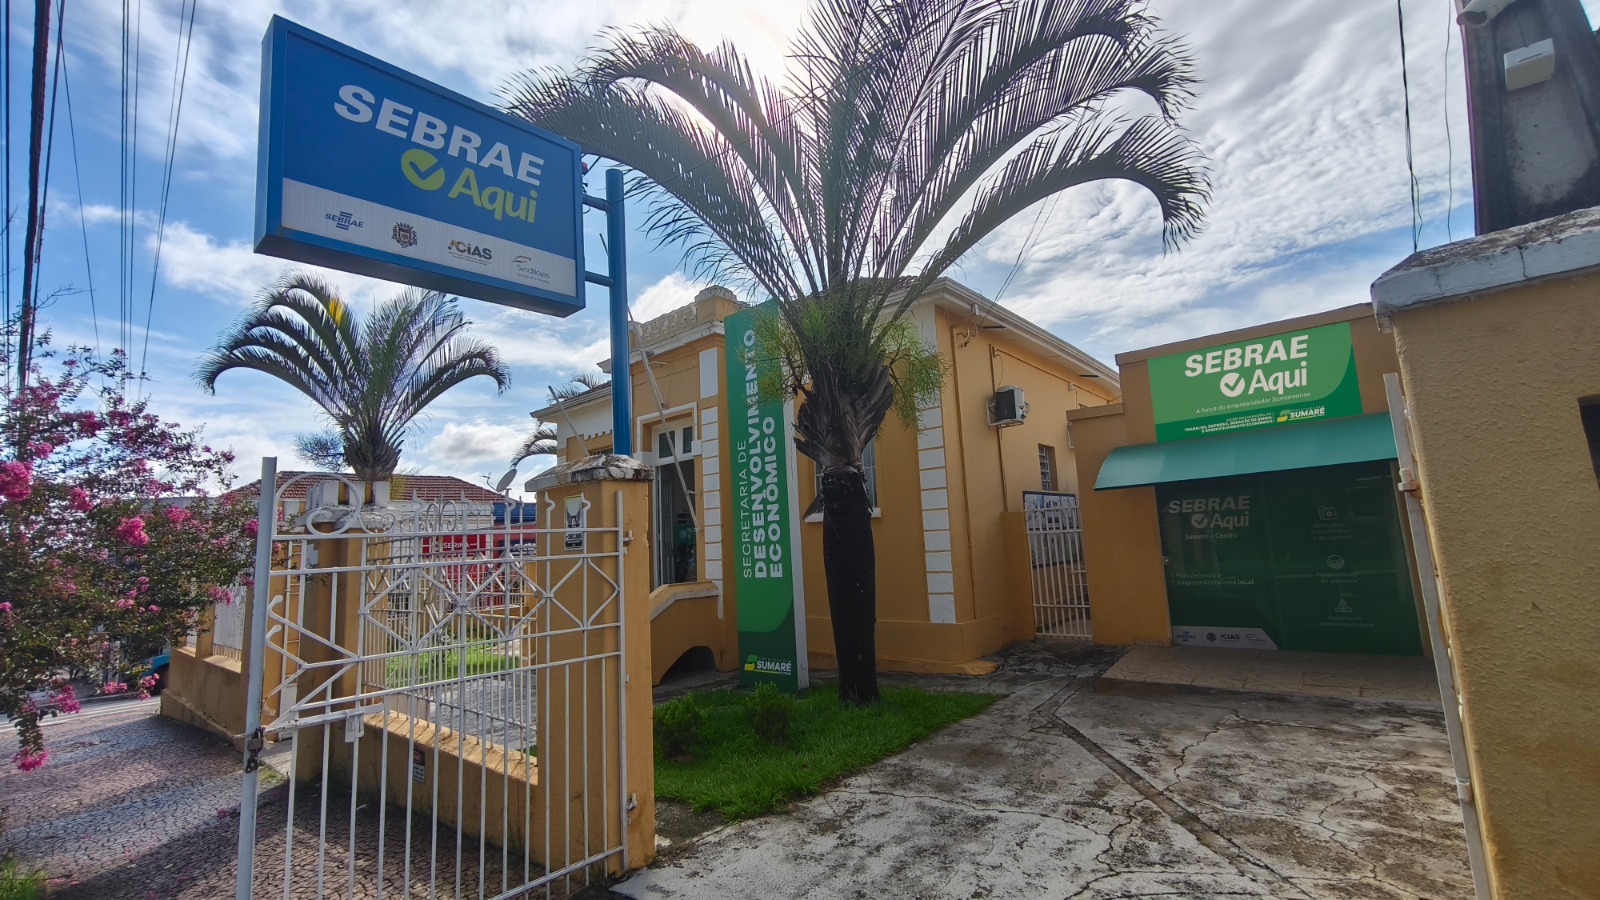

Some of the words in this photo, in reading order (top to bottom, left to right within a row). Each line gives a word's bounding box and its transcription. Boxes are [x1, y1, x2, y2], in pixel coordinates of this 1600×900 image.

[334, 85, 544, 187] SEBRAE
[448, 167, 538, 224] Aqui
[325, 213, 364, 228] SEBRAE
[1184, 334, 1309, 377] SEBRAE
[1248, 361, 1307, 395] Aqui
[1201, 405, 1217, 414] força
[1272, 392, 1311, 403] Sumareense
[1289, 407, 1325, 418] SUMARÉ
[737, 440, 747, 463] DE
[743, 329, 767, 579] DESENVOLVIMENTO
[762, 416, 783, 578] ECONÔMICO
[1168, 495, 1250, 514] SEBRAE
[738, 468, 752, 578] SECRETARIA
[1209, 511, 1249, 531] Aqui
[757, 660, 791, 672] SUMARÉ
